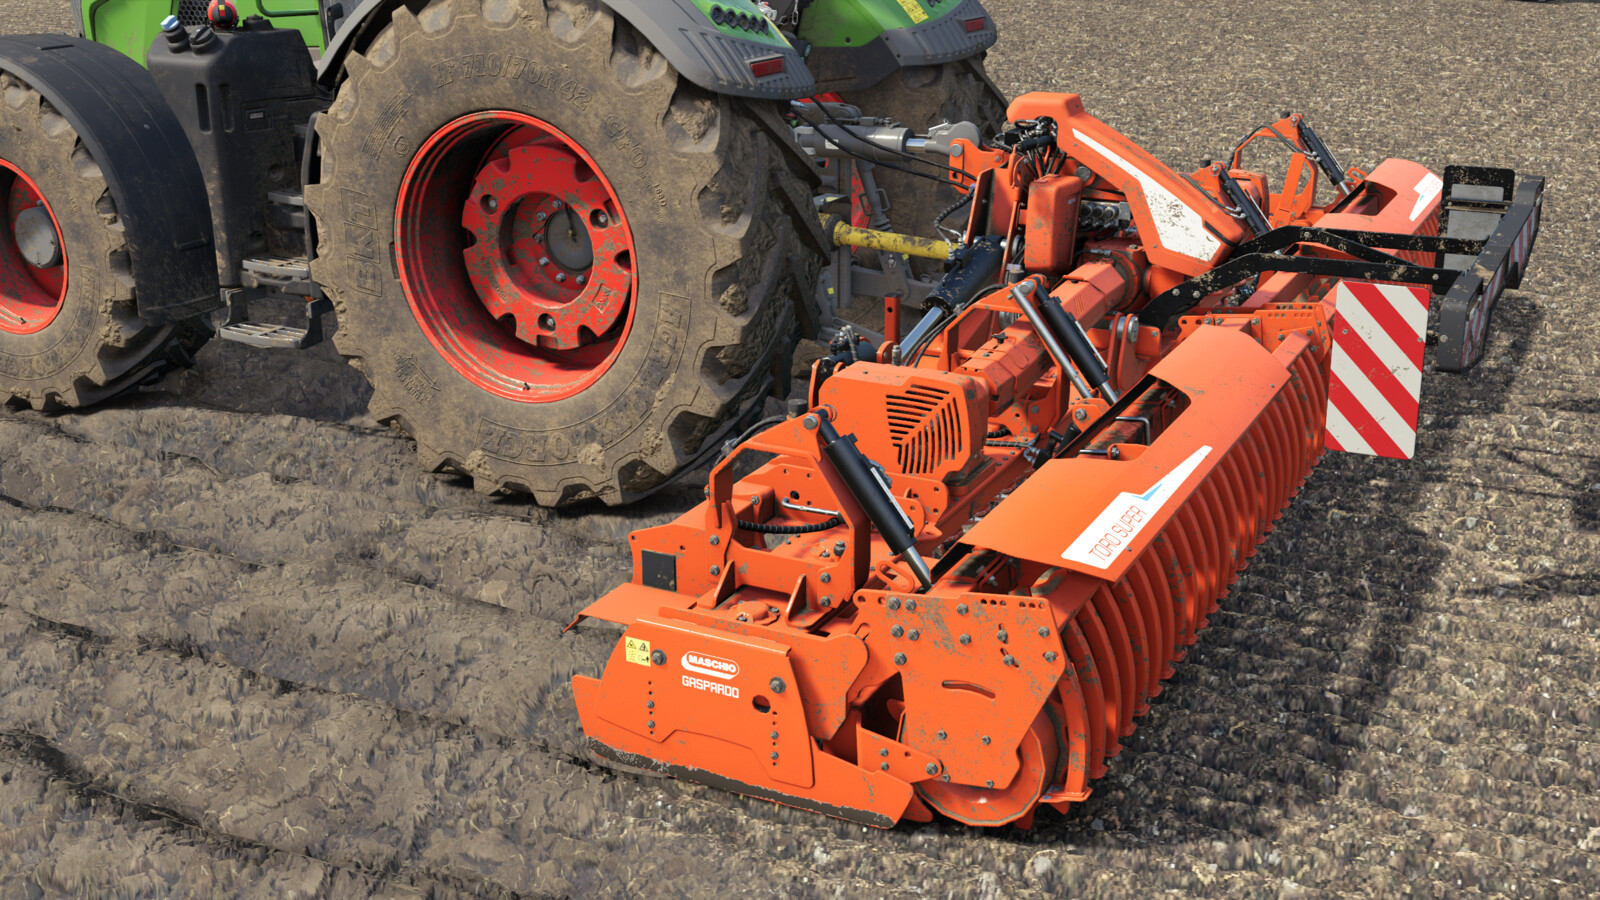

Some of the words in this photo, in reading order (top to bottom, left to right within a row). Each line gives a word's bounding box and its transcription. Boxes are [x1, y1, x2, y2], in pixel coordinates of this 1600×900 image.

[344, 187, 382, 297] BKT
[1088, 532, 1122, 562] TORO
[1111, 505, 1147, 538] SUPER
[688, 654, 737, 673] MASCHIO
[682, 675, 739, 699] GASPARDO
